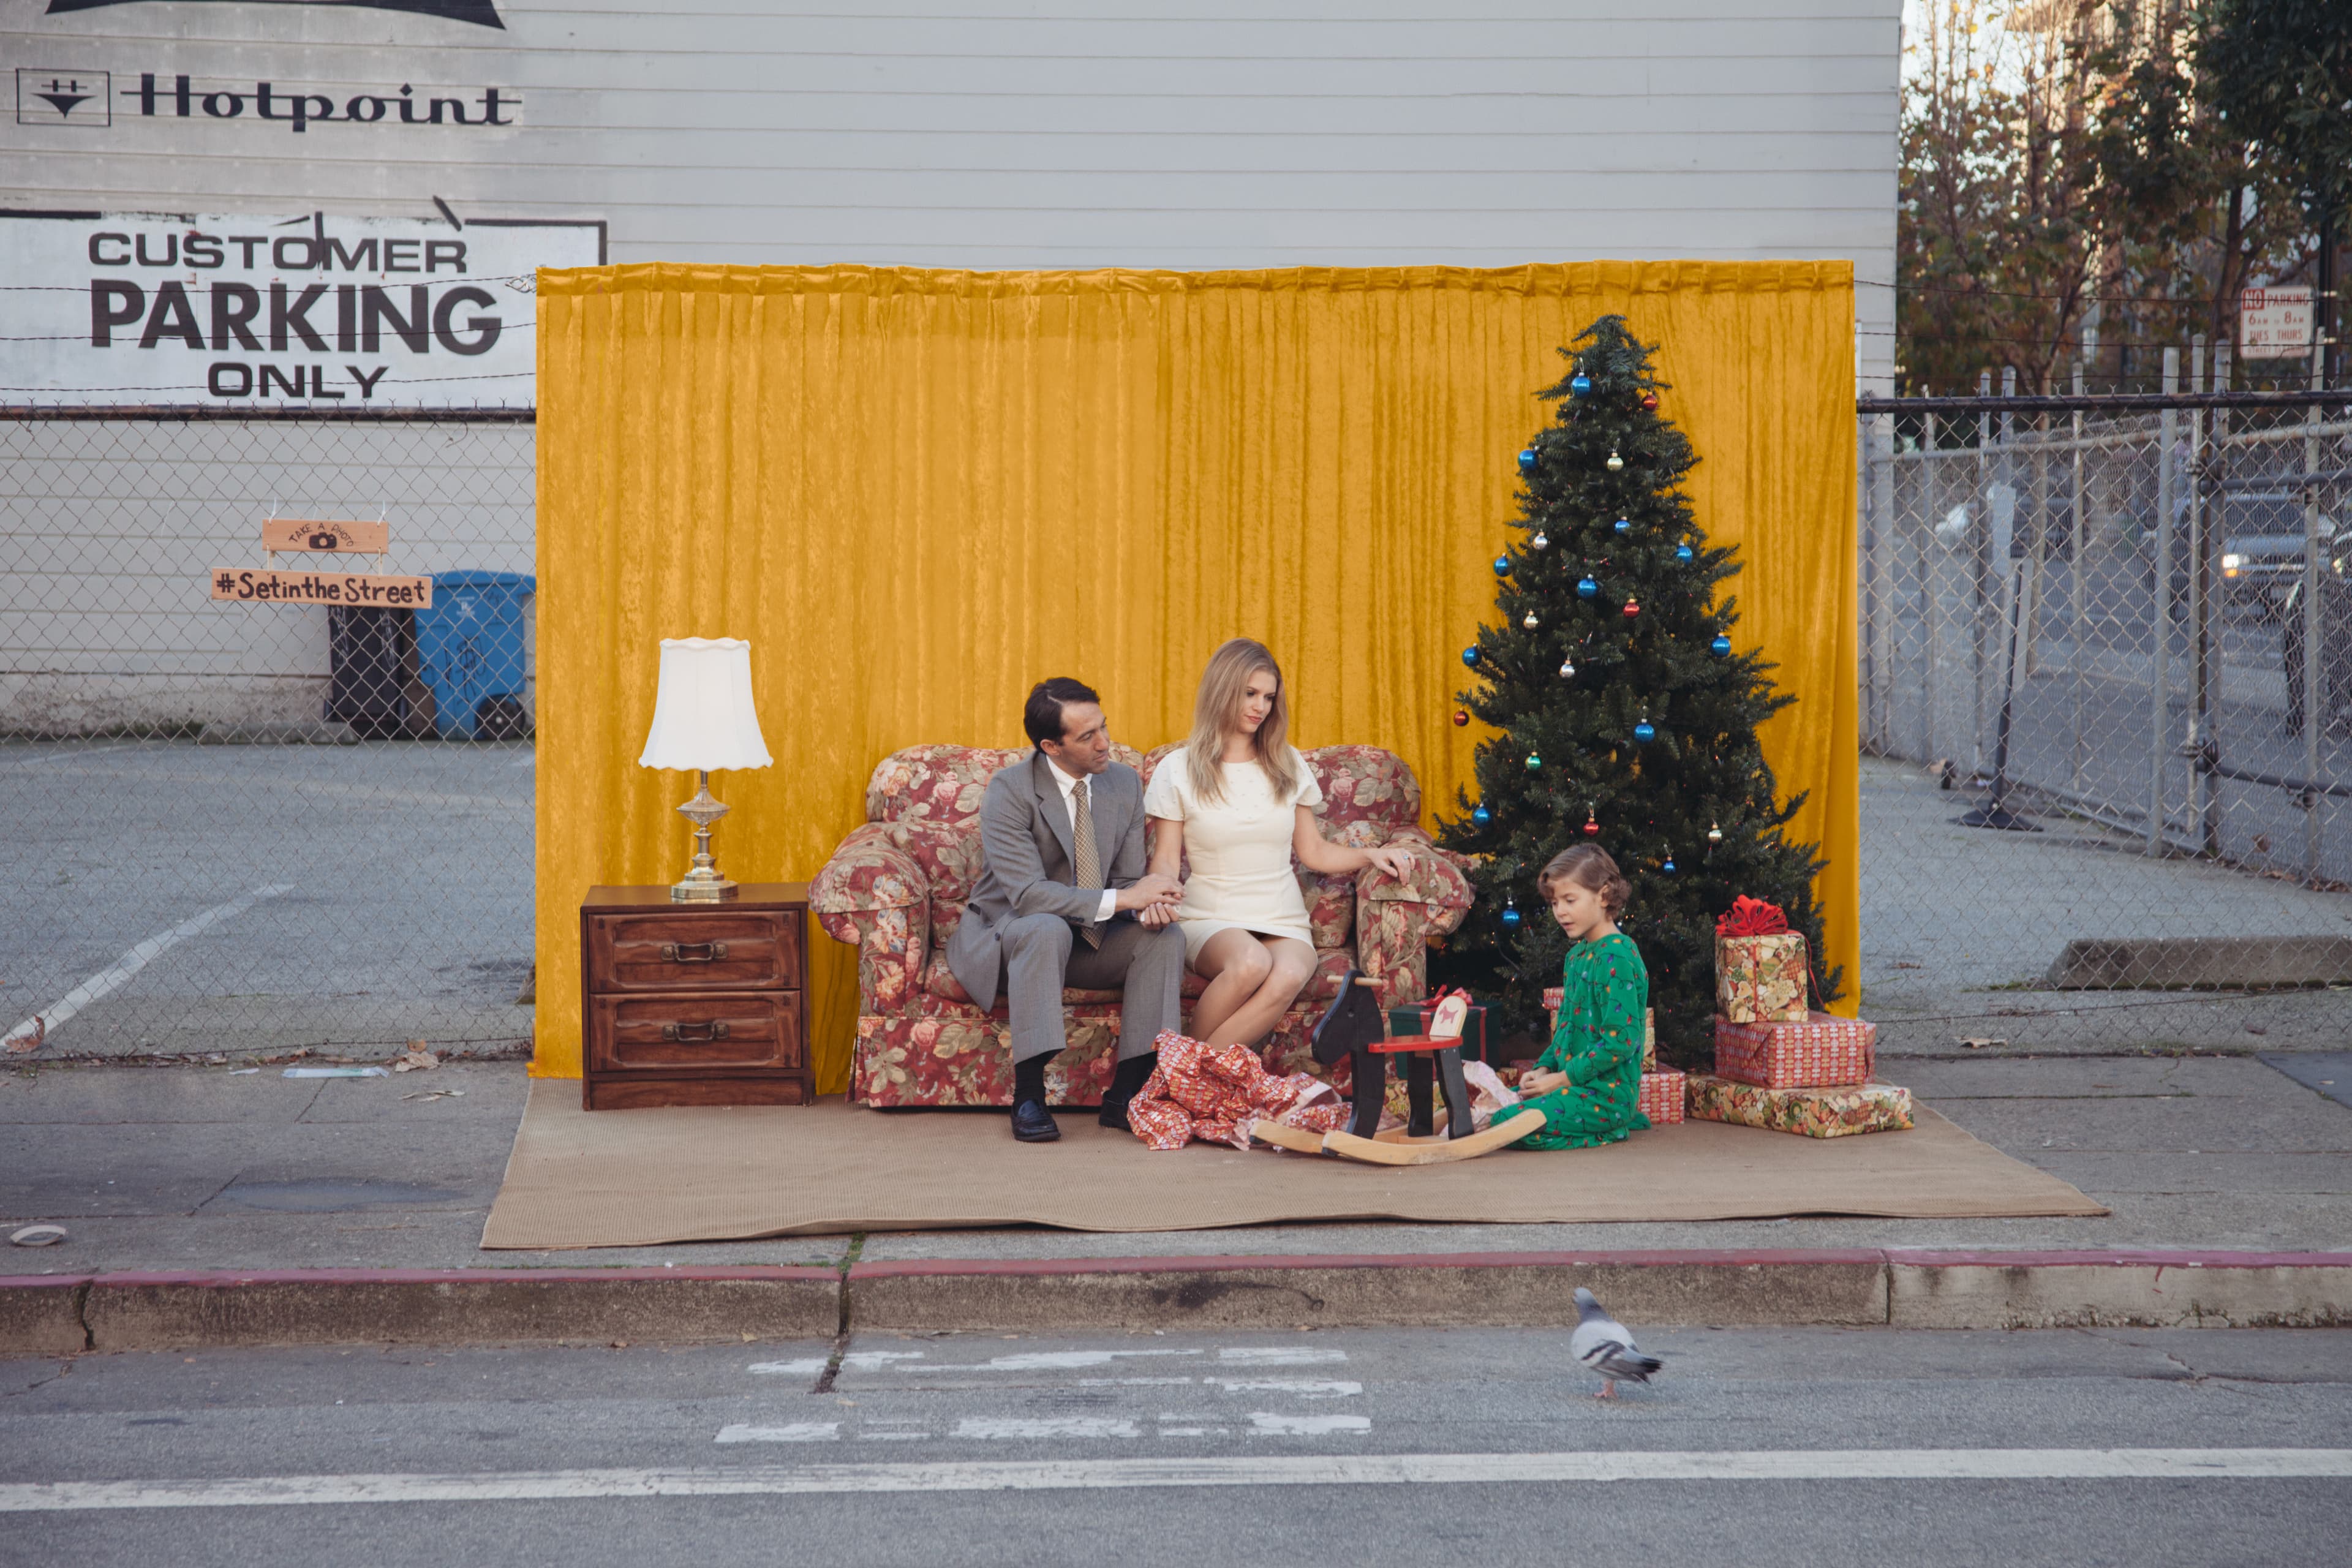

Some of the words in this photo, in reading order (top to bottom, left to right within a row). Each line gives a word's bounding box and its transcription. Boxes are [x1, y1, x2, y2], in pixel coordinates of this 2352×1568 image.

[121, 74, 521, 132] Hotpoint
[89, 232, 467, 273] CUSTOMER
[90, 280, 502, 355] PARKING
[2244, 290, 2263, 309] NO
[2267, 293, 2309, 307] PARKING
[2250, 329, 2269, 341] TUES
[2277, 328, 2303, 341] THURS
[208, 363, 389, 399] ONLY
[288, 523, 312, 543] TAKE
[331, 524, 354, 547] PHOTO
